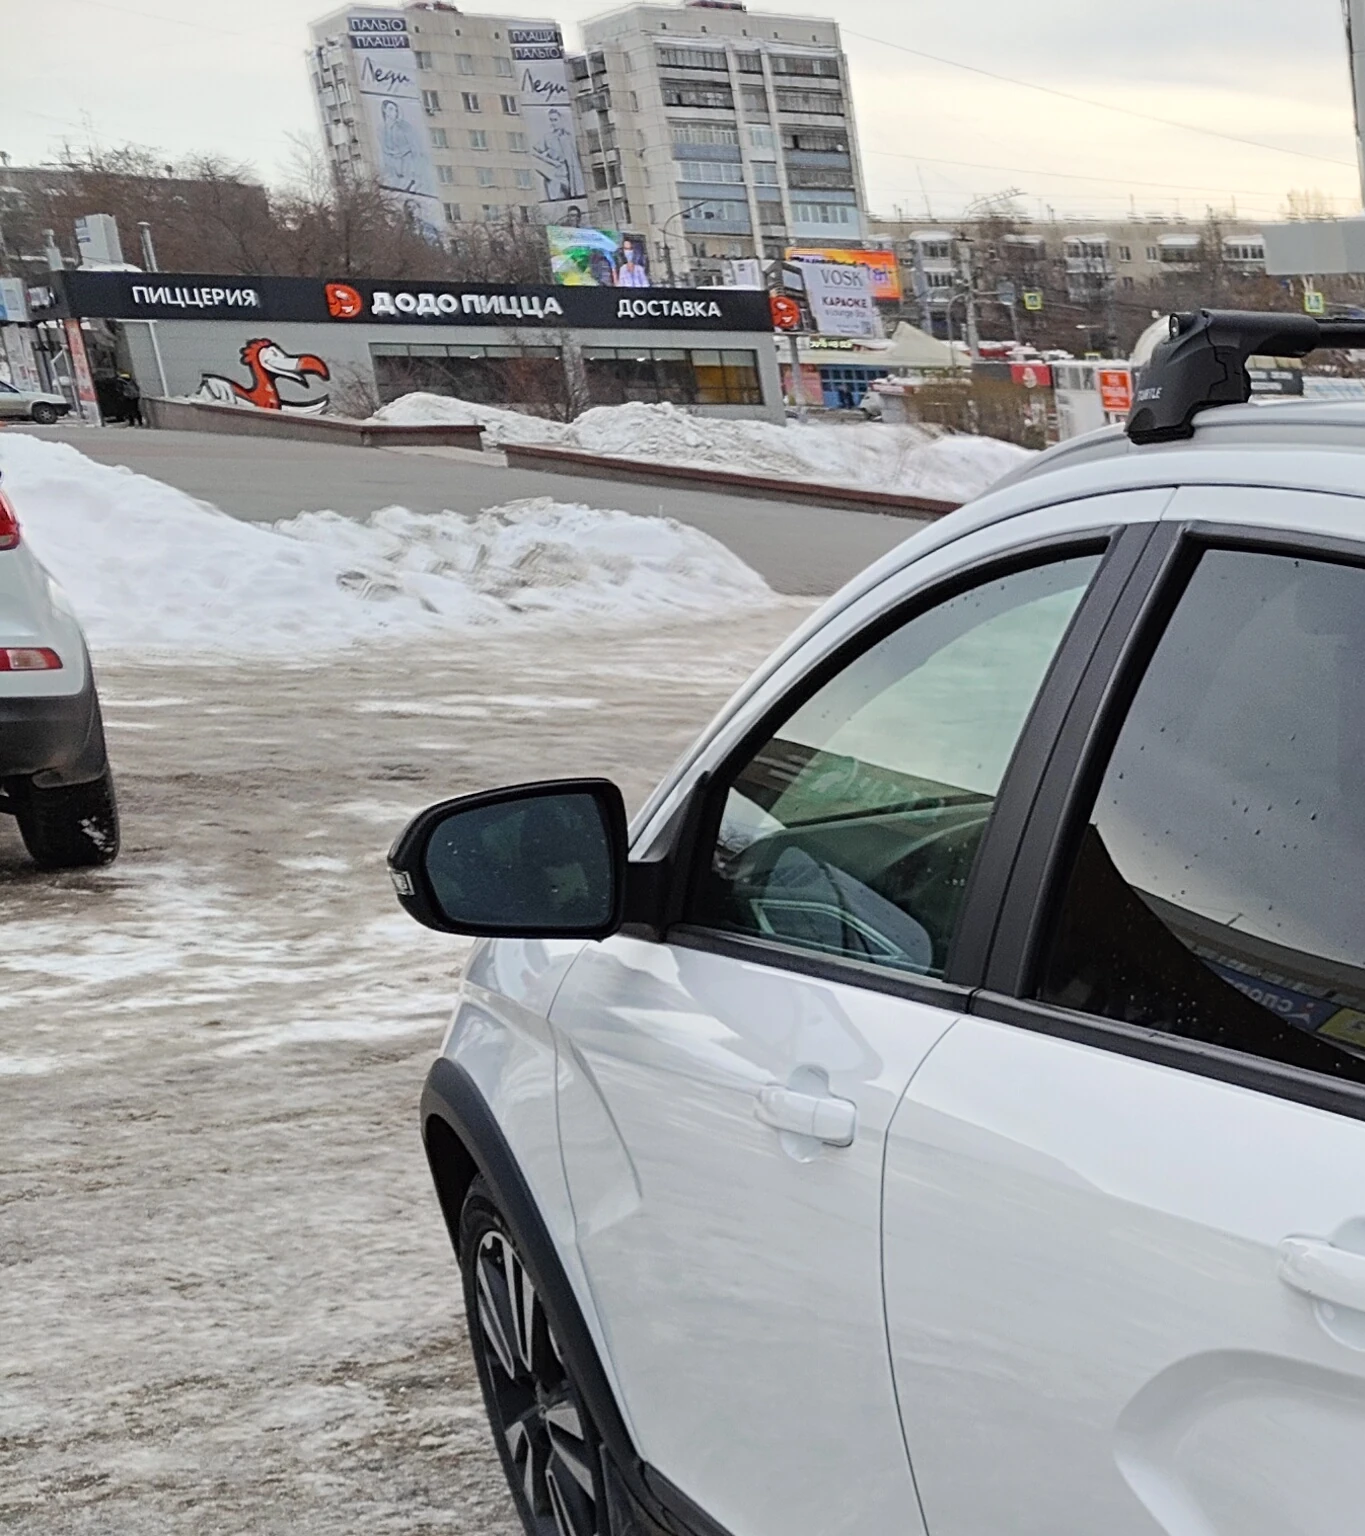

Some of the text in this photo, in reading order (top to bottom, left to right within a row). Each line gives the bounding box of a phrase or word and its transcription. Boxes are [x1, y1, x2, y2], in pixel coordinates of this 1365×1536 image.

[350, 18, 404, 32] ПАЛЬТО
[355, 35, 406, 48] ПЛАЩИ
[512, 29, 557, 43] ПЛАЩИ
[513, 47, 562, 60] ПАЛЬТО
[820, 269, 864, 287] VOSK
[131, 285, 258, 308] ПИЦЦЕРИЯ
[821, 296, 868, 309] КАРАОКЕ
[371, 291, 564, 319] ДОДО ПИЦЦА
[617, 298, 722, 319] ДОСТАВКА
